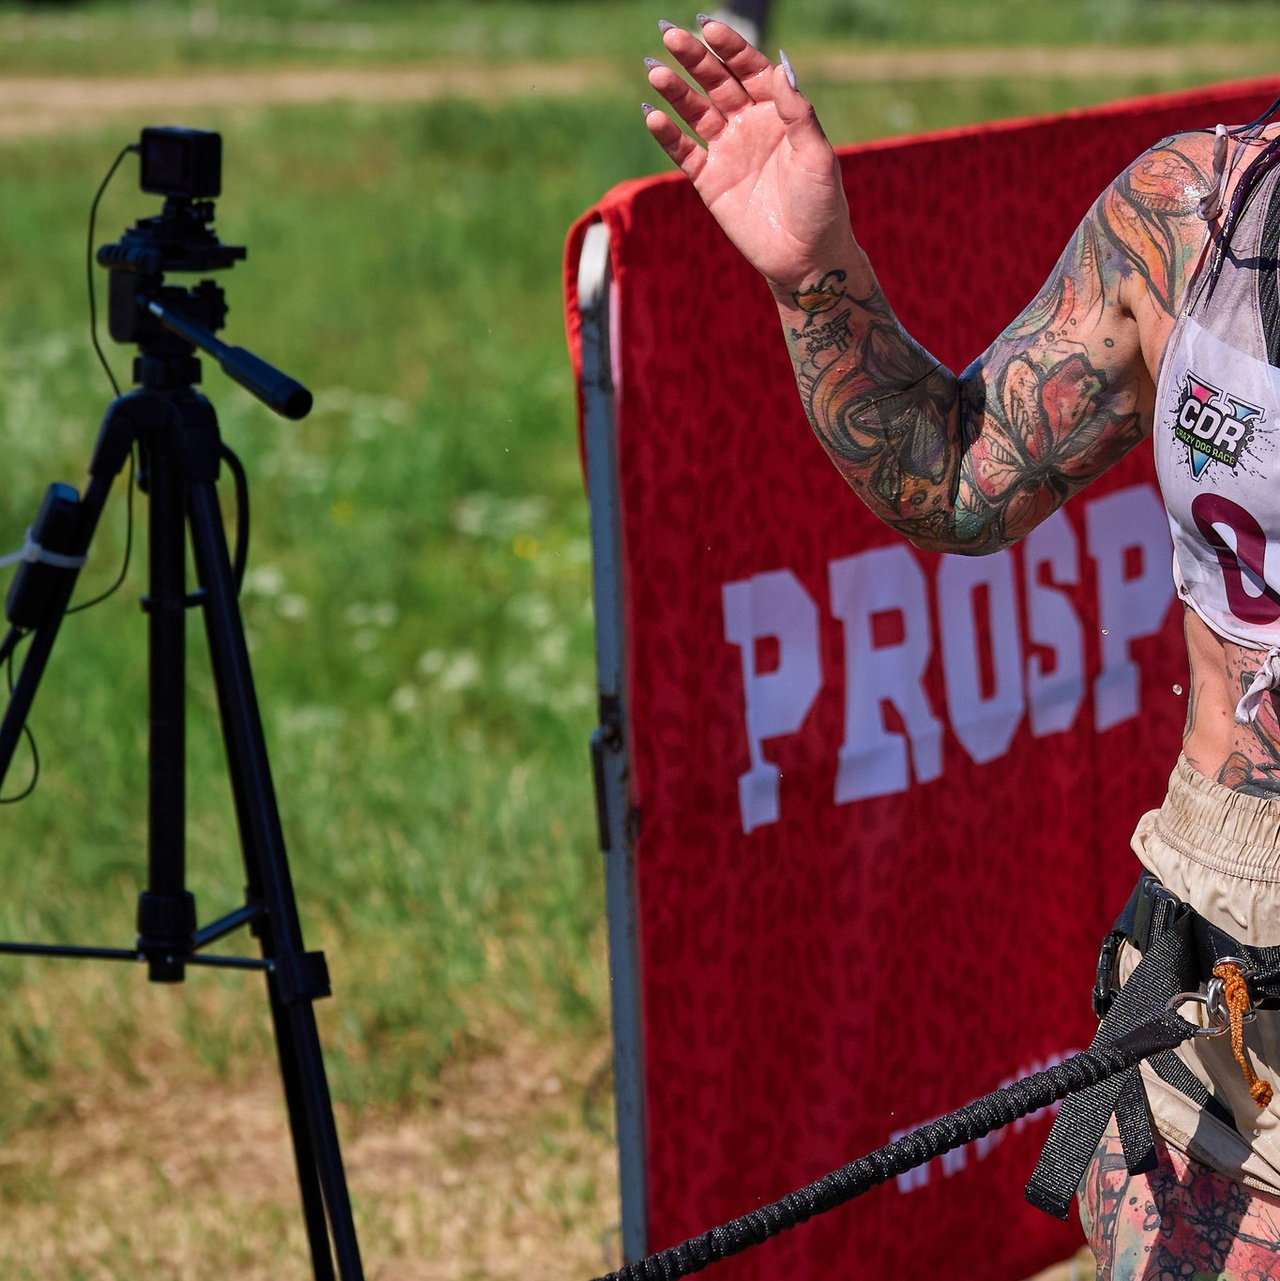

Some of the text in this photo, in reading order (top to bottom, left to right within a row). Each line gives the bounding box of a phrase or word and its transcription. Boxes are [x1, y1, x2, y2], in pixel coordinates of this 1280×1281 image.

[1175, 427, 1236, 465] CRAZY DOG RACE
[1179, 398, 1246, 453] CDR
